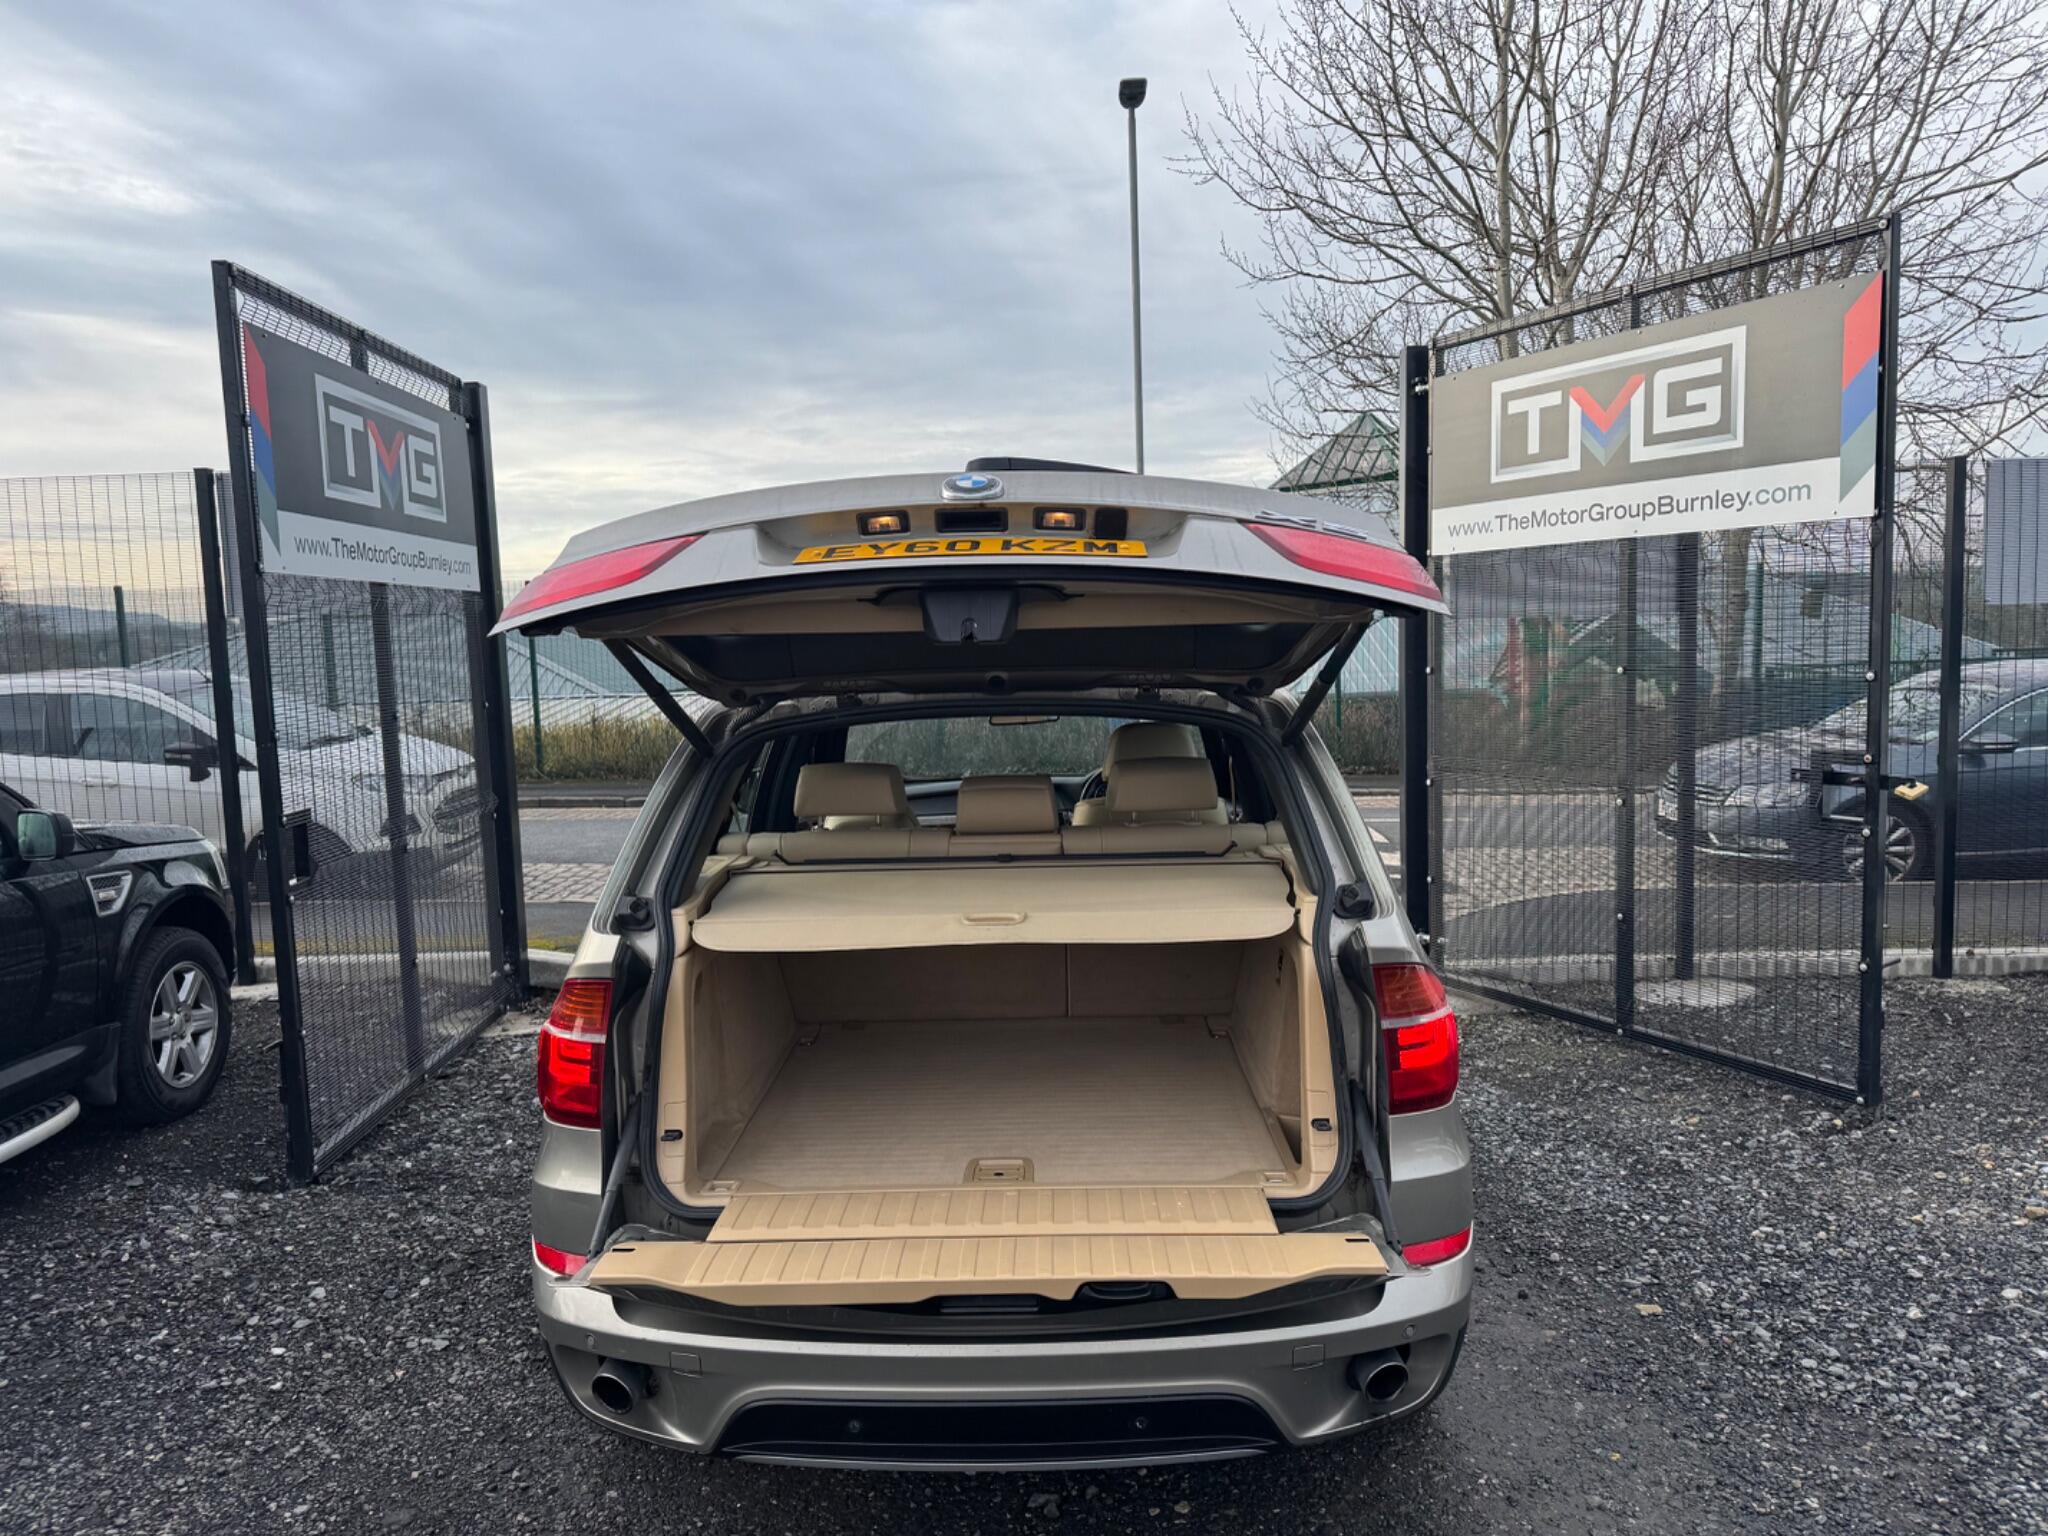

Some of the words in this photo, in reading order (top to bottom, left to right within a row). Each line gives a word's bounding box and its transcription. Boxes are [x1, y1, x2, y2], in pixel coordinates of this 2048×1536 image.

[1507, 356, 1724, 470] TMG
[328, 404, 439, 511] TMG
[1447, 482, 1812, 538] www.TheMotorGroupBurnley.com
[294, 535, 471, 576] www.TheMotorGroupBurnley.com
[819, 538, 982, 560] EY60
[1000, 538, 1119, 554] KZM
